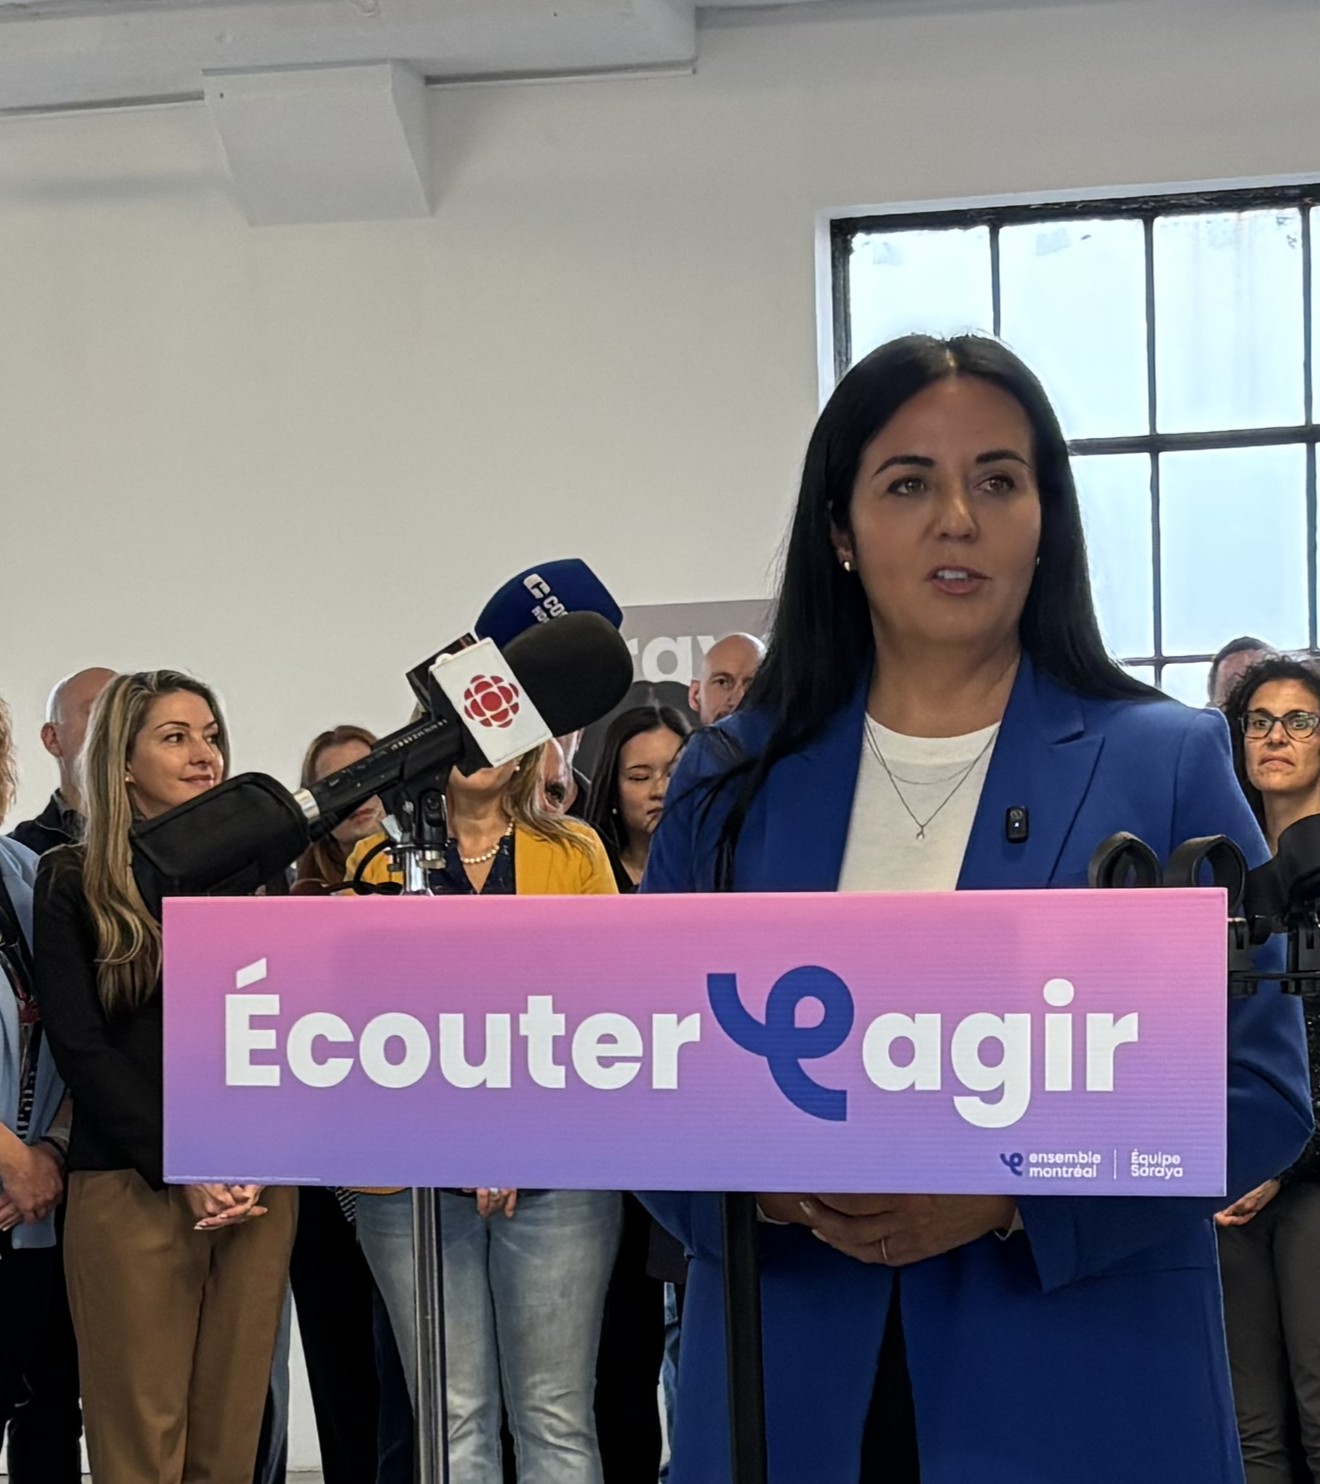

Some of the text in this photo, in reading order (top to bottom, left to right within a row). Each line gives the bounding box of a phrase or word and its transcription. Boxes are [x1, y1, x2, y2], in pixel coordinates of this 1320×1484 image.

[225, 957, 1139, 1129] Écouter agir
[1028, 1150, 1102, 1164] ensemble
[1130, 1148, 1181, 1166] Équipe
[1028, 1164, 1097, 1178] montréal
[1130, 1164, 1184, 1180] Soraya
